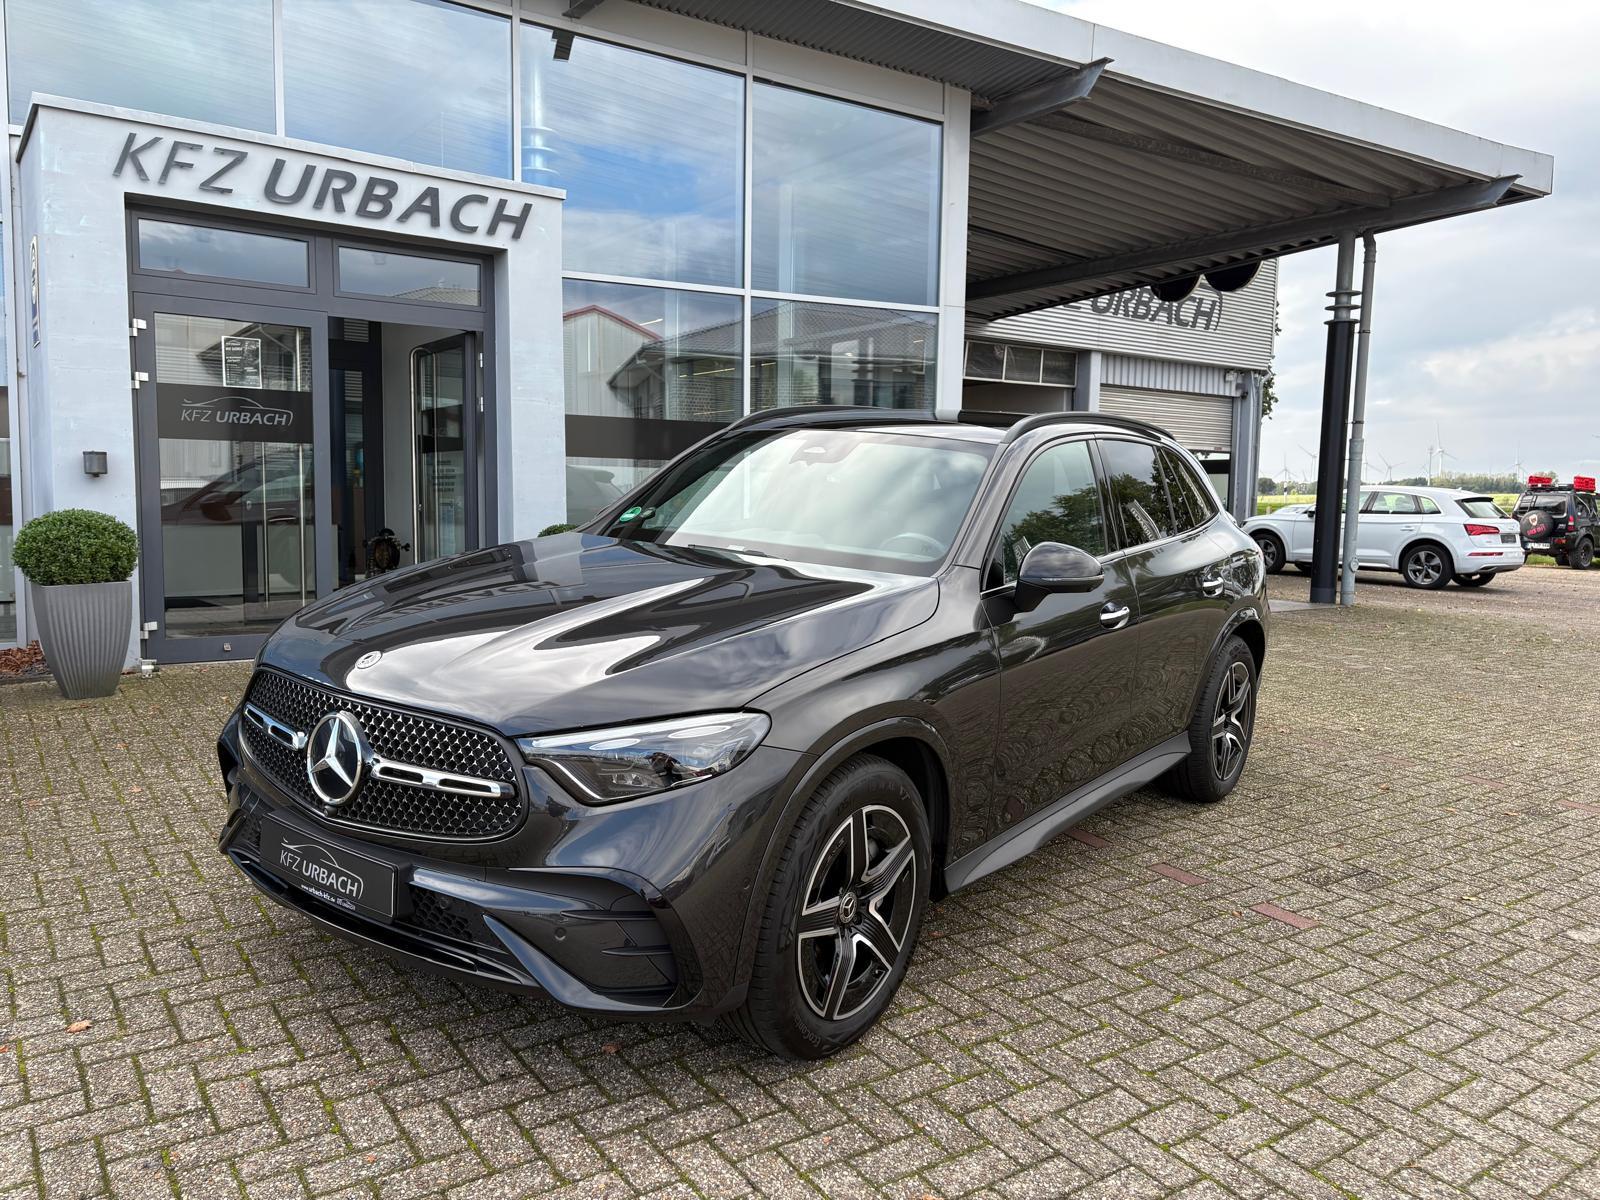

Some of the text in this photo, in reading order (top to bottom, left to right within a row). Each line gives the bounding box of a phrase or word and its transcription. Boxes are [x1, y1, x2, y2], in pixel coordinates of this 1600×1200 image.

[112, 132, 533, 241] KFZ URBACH
[181, 409, 287, 426] KFZ URBACH
[279, 849, 359, 898] KFZ URBACH
